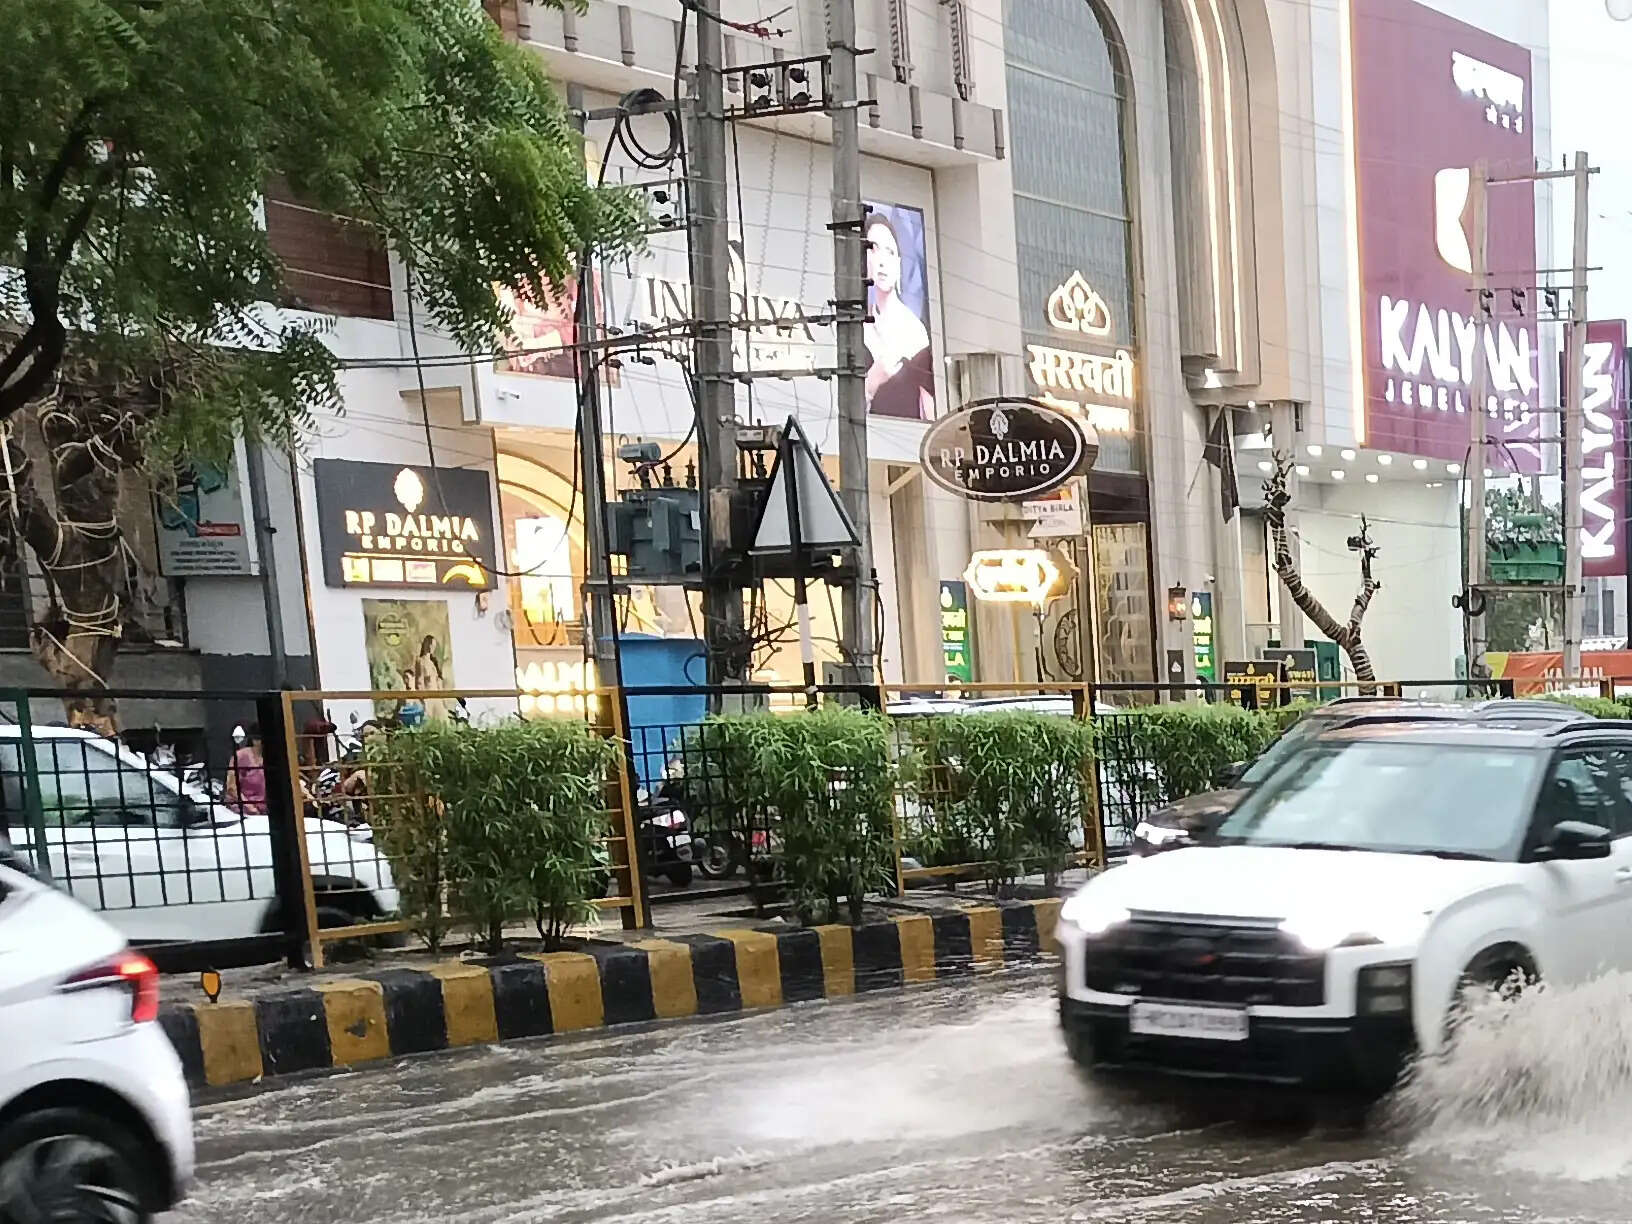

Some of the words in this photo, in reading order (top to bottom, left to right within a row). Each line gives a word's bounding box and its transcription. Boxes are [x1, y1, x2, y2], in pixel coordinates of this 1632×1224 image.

[646, 277, 816, 343] INRIYA
[1385, 378, 1530, 425] JEWELERS
[940, 447, 966, 468] RP
[976, 438, 1065, 465] DALMIA
[1580, 342, 1615, 559] KALYAN
[954, 463, 1050, 481] EMPORIO
[345, 510, 376, 535] RP
[385, 512, 480, 541] DALMIA
[361, 535, 464, 553] EMPORIO
